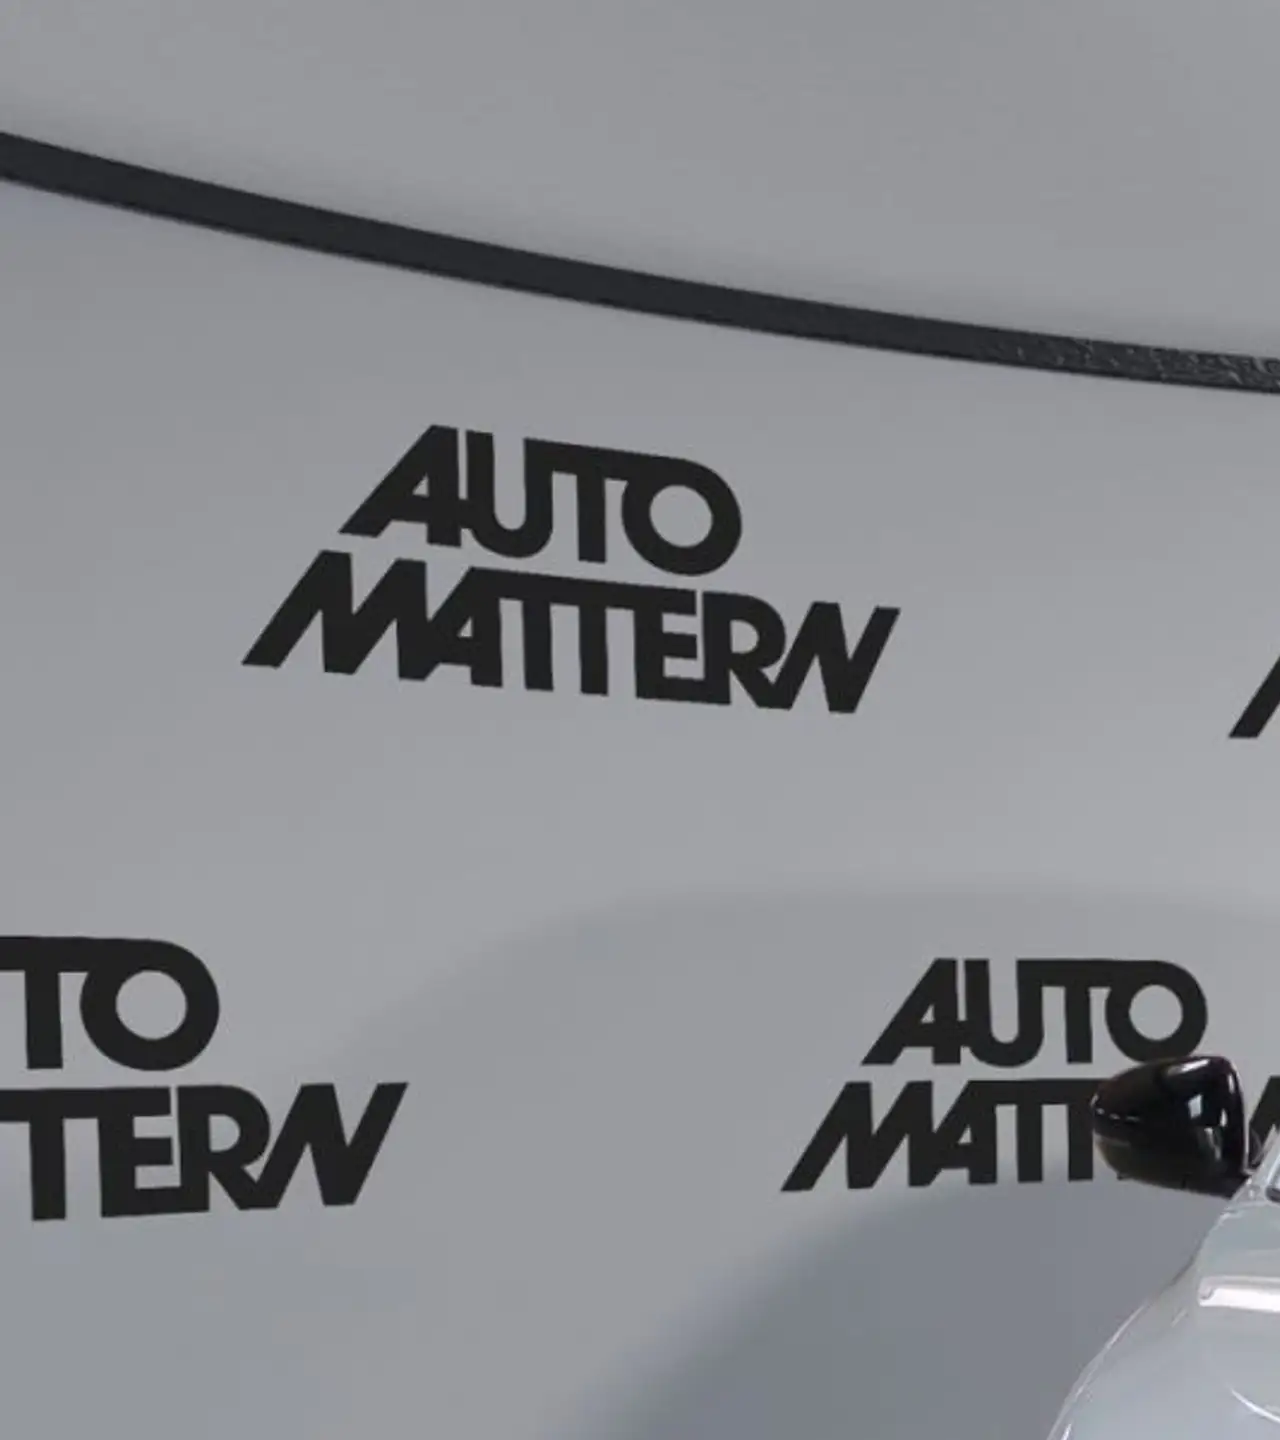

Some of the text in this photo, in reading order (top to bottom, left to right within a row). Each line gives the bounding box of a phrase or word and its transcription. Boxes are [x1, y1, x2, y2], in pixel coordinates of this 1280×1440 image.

[340, 425, 742, 577] AUTO
[243, 550, 900, 714] MATTERN
[0, 935, 220, 1071] TO
[861, 958, 1208, 1067] AUTO
[0, 1082, 408, 1221] TERN
